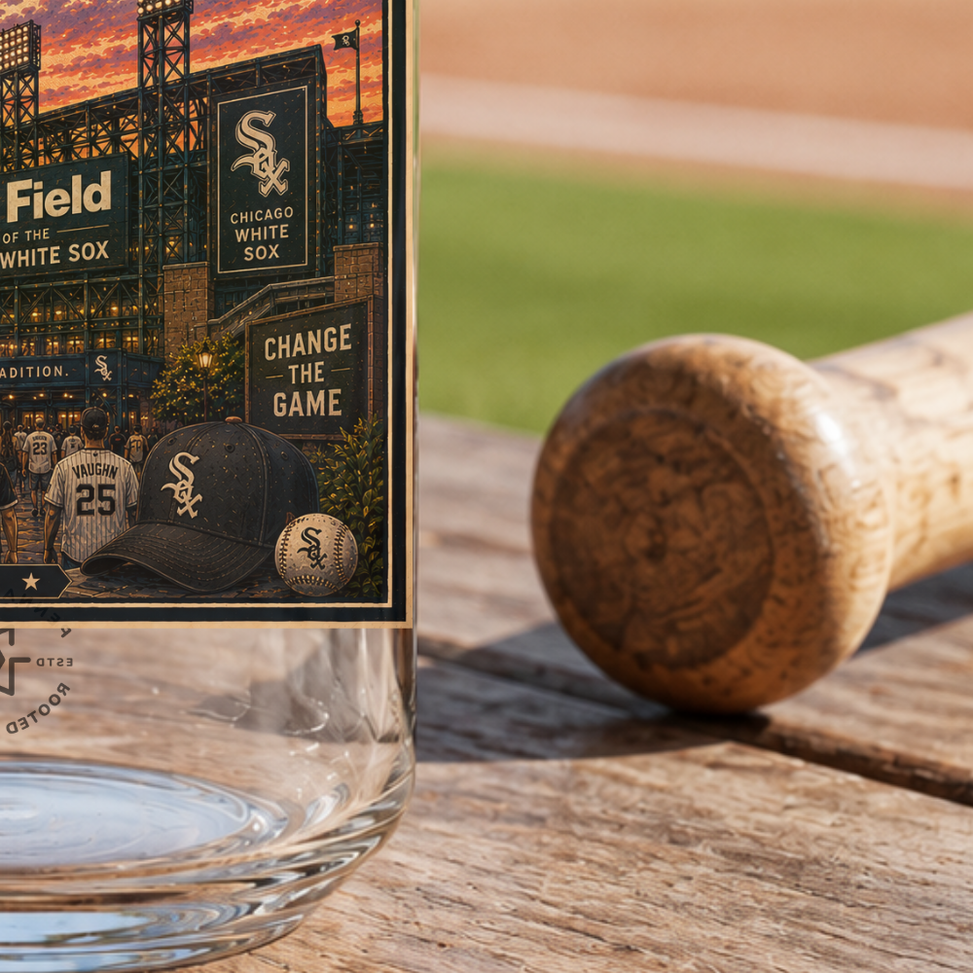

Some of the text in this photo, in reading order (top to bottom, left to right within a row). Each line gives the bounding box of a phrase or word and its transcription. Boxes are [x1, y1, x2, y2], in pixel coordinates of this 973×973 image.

[6, 170, 112, 223] Field
[230, 206, 294, 225] CHICAGO
[1, 232, 20, 245] OF
[23, 227, 51, 243] THE
[234, 224, 290, 243] WHITE
[0, 246, 61, 271] WHITE
[68, 239, 110, 263] SOX
[243, 245, 281, 262] SOX
[265, 324, 352, 361] CHANGE
[287, 363, 325, 386] THE
[272, 388, 343, 419] GAME
[32, 441, 48, 456] 23
[72, 462, 119, 480] VAUGHN
[75, 483, 116, 517] 25
